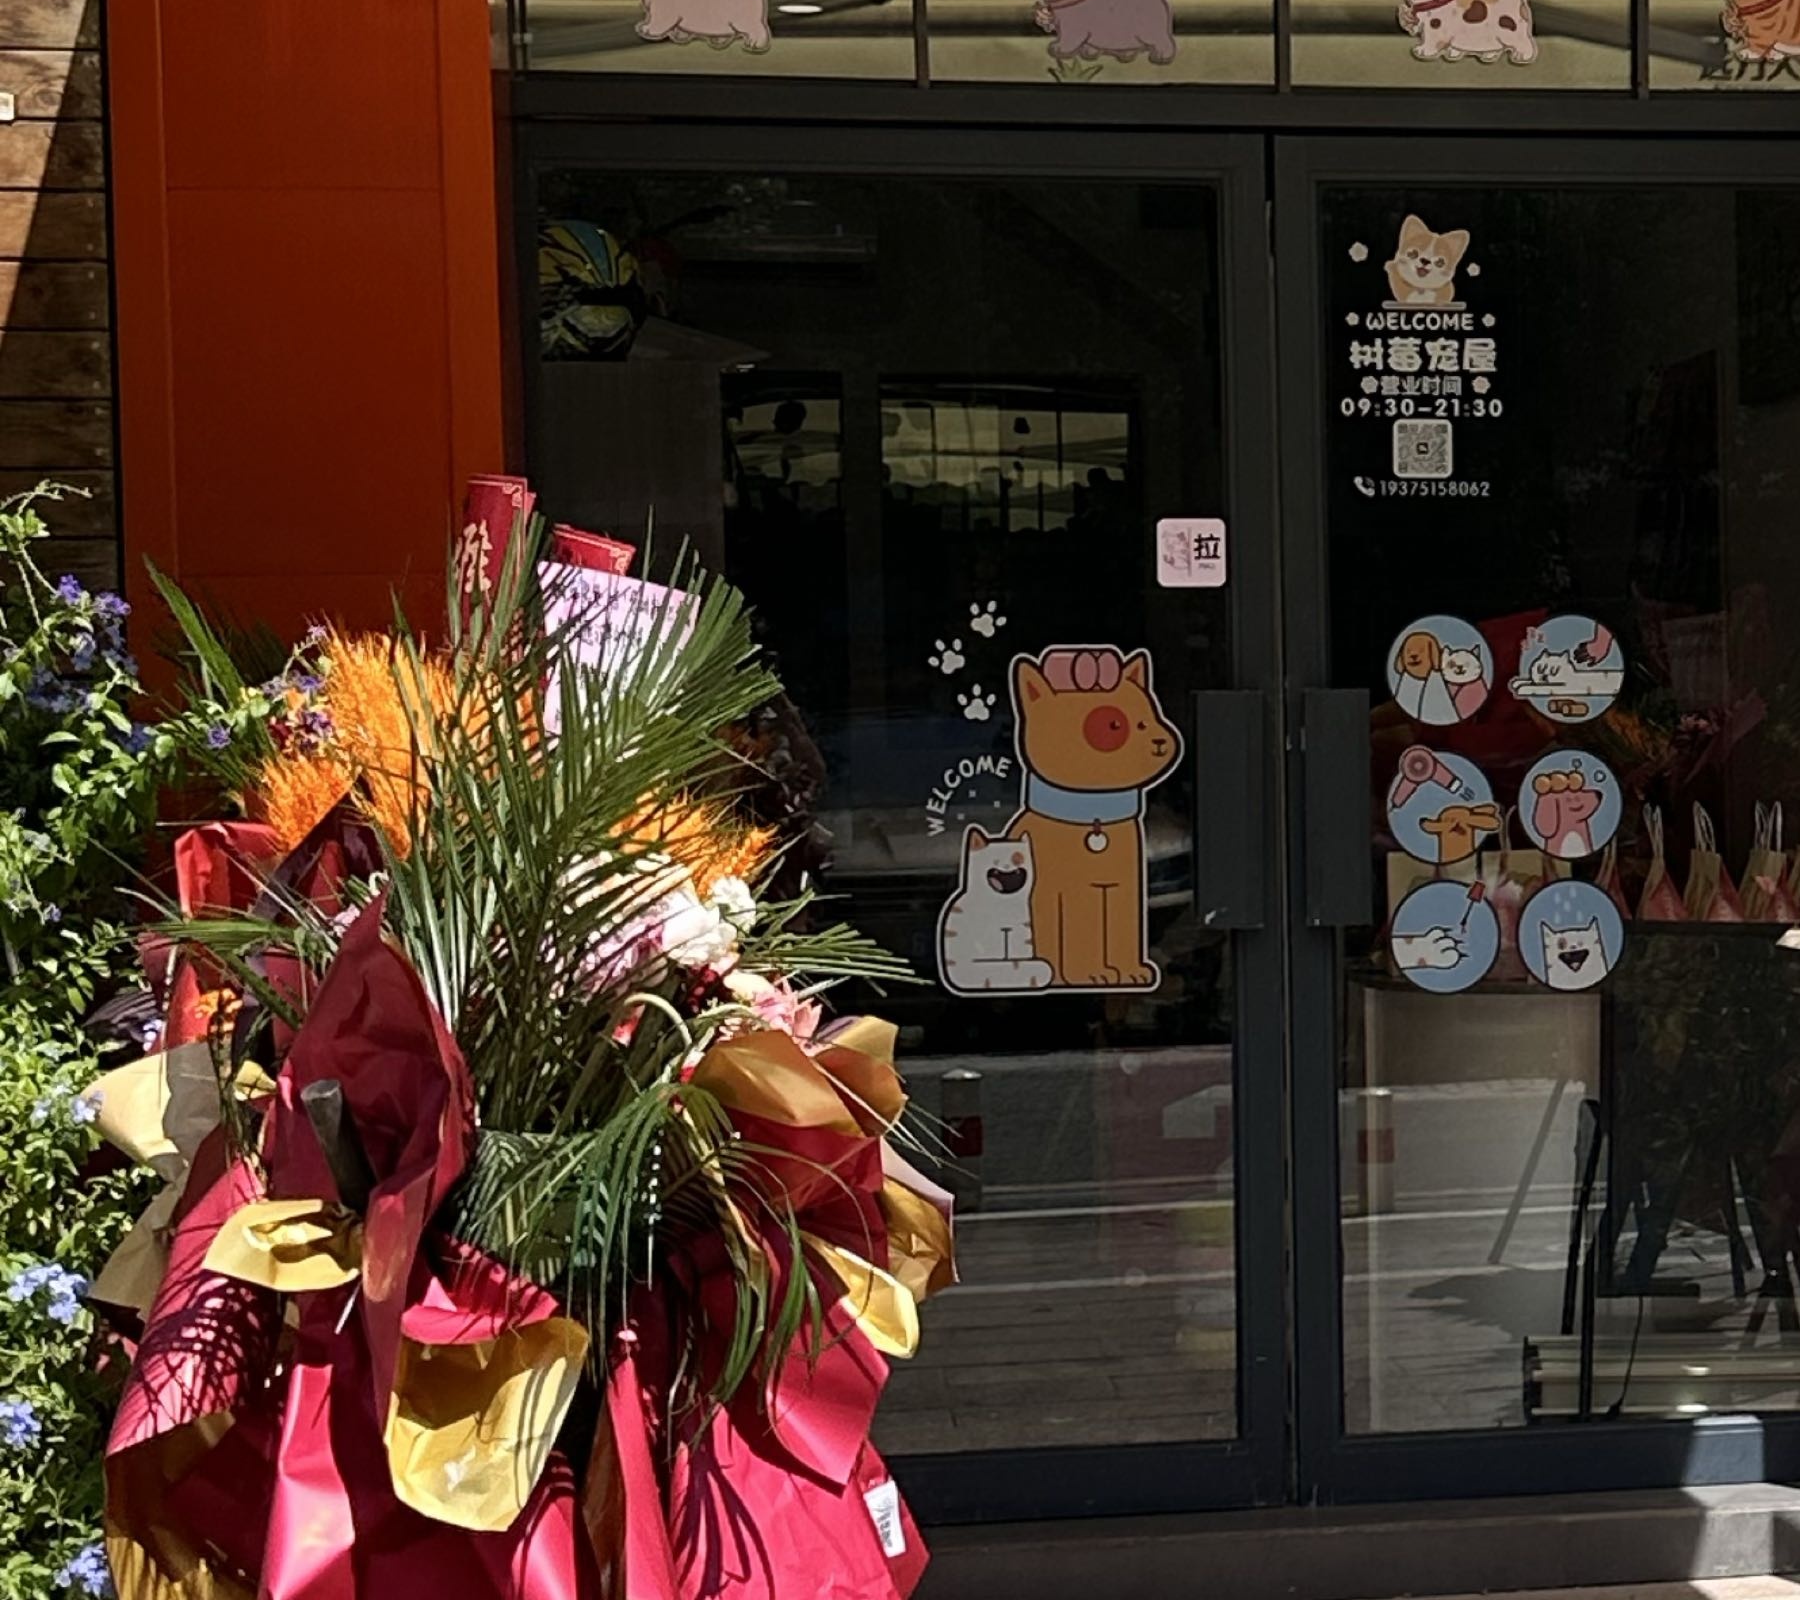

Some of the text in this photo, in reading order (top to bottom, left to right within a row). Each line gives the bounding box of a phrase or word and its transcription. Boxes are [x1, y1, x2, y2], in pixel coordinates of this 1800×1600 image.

[1365, 311, 1475, 332] WELCOME
[1349, 336, 1498, 373] 树莓宠屋
[1380, 375, 1462, 396] 营业时间
[1340, 397, 1504, 418] 09:30-21:30
[1379, 480, 1491, 498] 19375158062
[1193, 532, 1222, 561] 拉
[926, 754, 1013, 838] WELCOME
